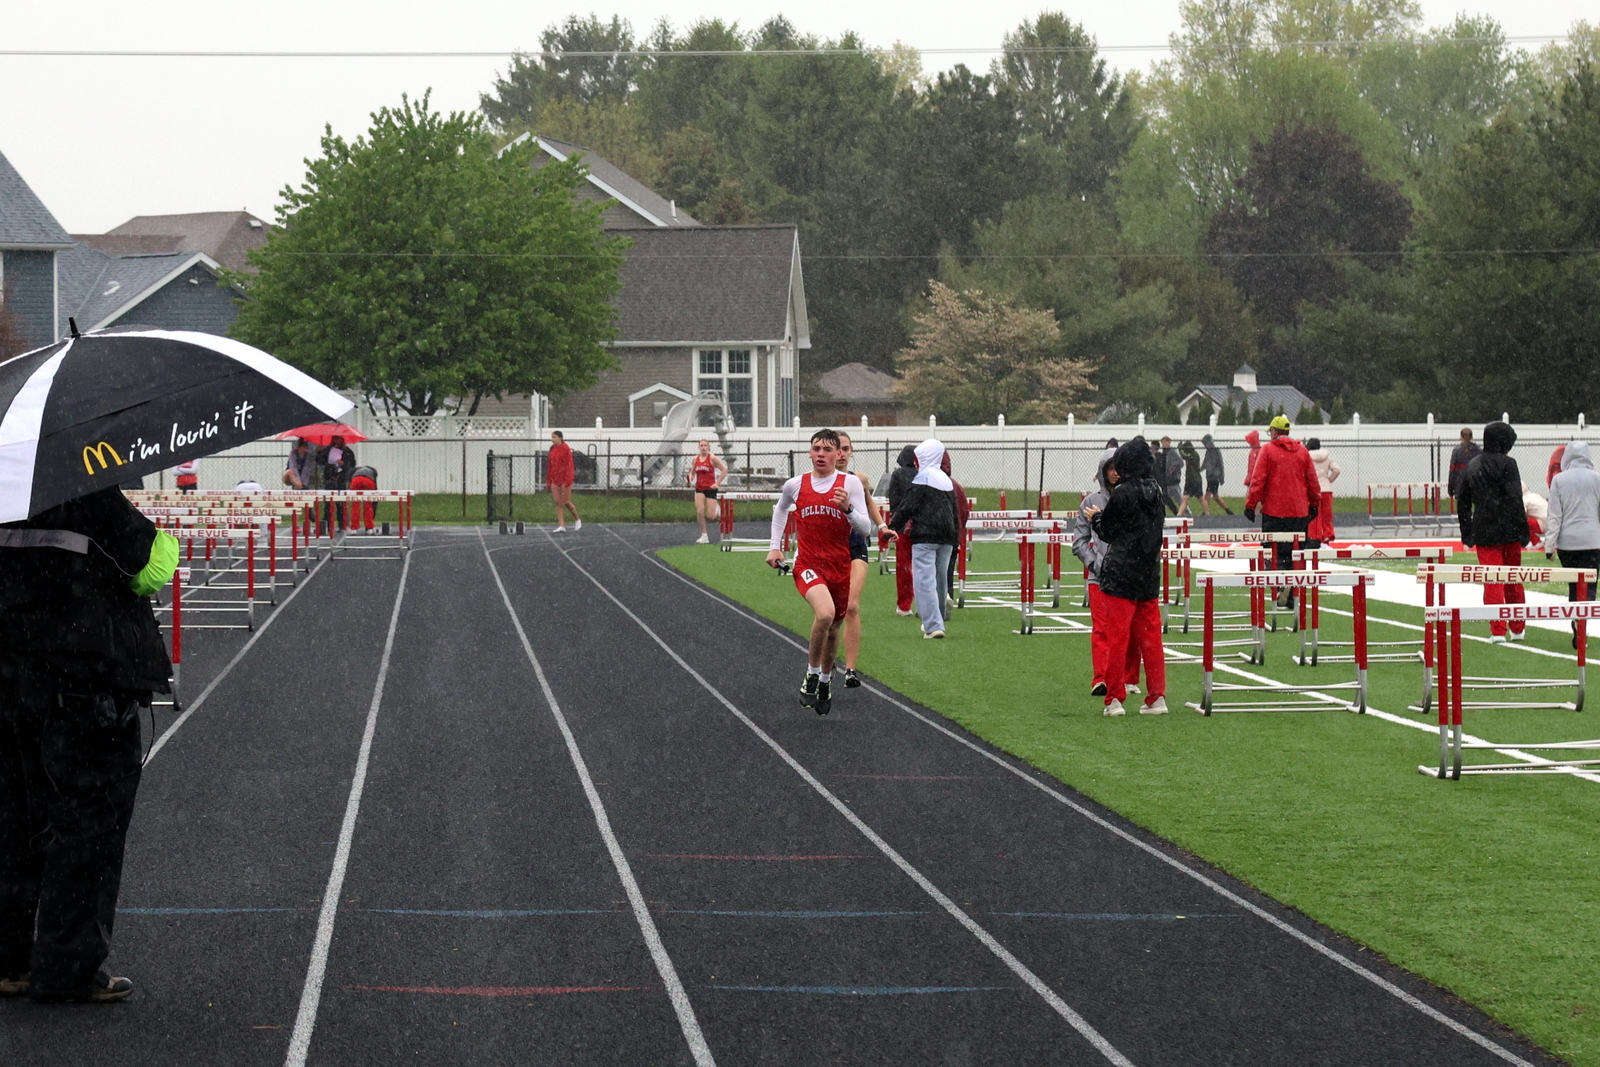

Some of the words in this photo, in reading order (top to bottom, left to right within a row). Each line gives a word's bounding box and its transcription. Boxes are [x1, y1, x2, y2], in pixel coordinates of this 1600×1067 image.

[129, 437, 160, 464] i'm
[170, 411, 220, 452] lovin'
[234, 400, 254, 430] it
[801, 505, 842, 519] BELLEVUE
[1210, 534, 1273, 542] BELLEVUE
[1160, 550, 1235, 559] BELLEVUE
[805, 570, 815, 580] 4
[1245, 575, 1328, 585] BELLEVUE
[1461, 572, 1550, 582] BELLEVUE
[1499, 605, 1600, 618] BELLEVUE
